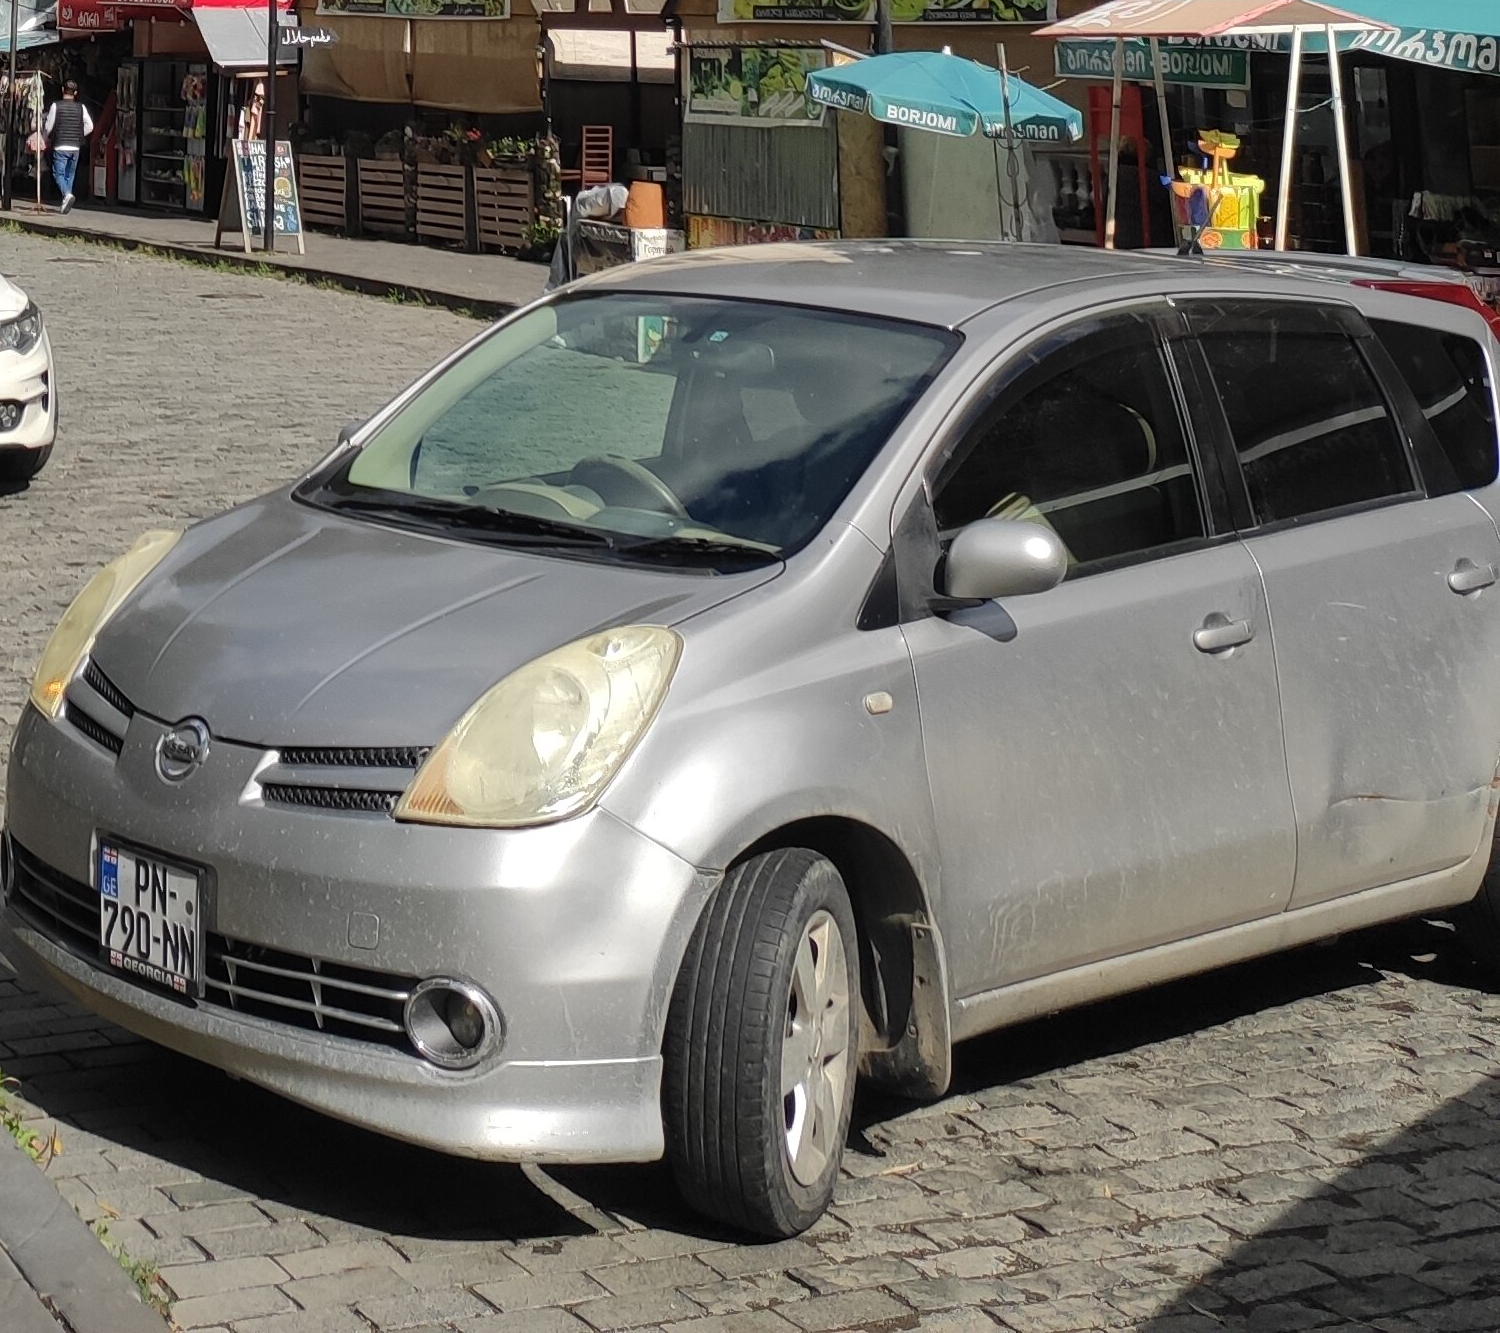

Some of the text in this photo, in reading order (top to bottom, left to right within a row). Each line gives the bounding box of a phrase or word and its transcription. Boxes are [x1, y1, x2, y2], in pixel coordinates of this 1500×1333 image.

[1160, 52, 1233, 76] BORJOMI
[1349, 30, 1500, 72] ბორჯომ
[887, 104, 956, 131] BORJOMI
[102, 875, 117, 897] GE
[135, 857, 177, 916] PN-
[103, 899, 195, 981] 790-NN
[123, 956, 173, 988] GEORGIA
